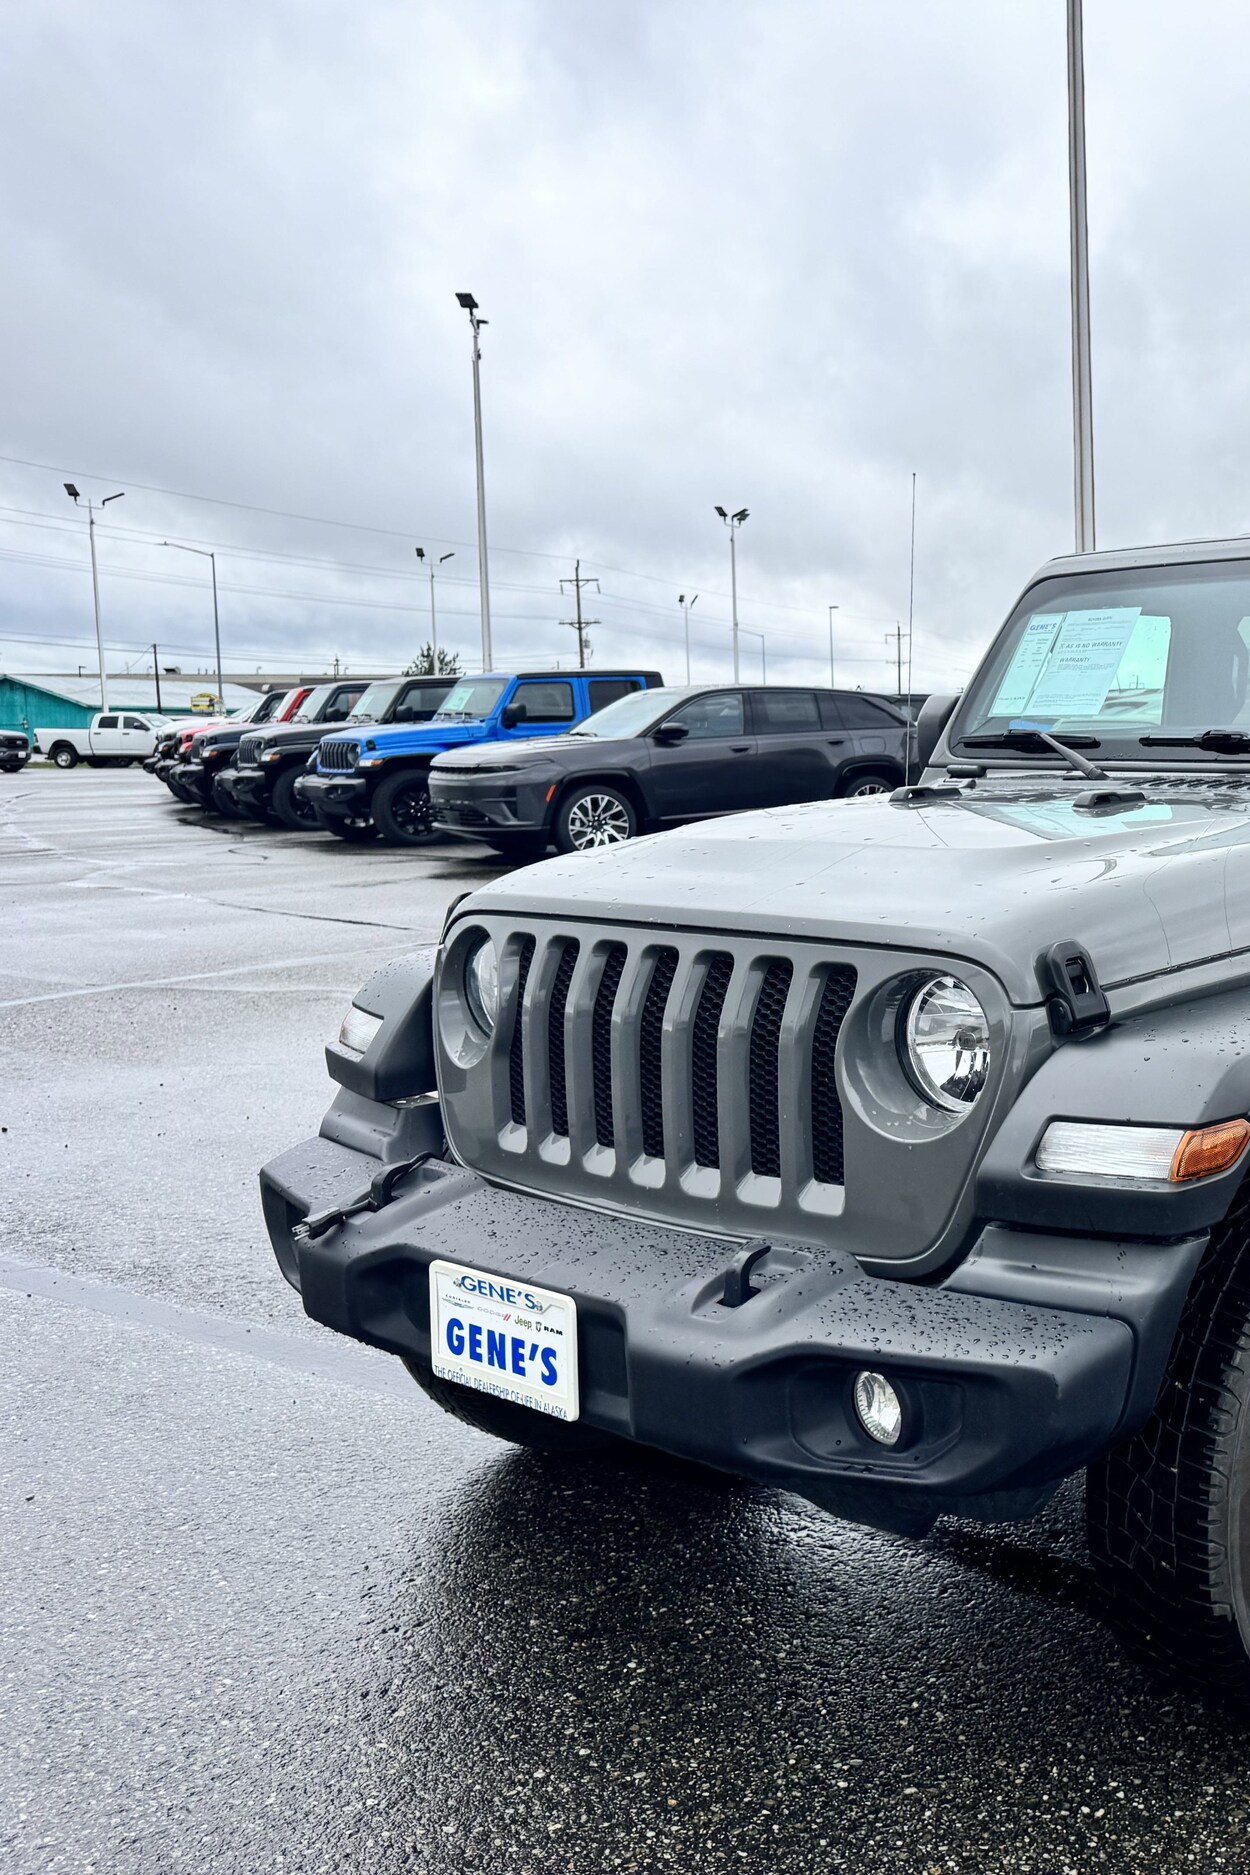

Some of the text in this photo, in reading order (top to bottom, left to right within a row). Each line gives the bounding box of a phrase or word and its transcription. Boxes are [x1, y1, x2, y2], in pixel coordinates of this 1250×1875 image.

[460, 1275, 537, 1310] GENE'S
[514, 1315, 533, 1331] Jeep
[543, 1326, 563, 1336] RAM
[446, 1317, 558, 1386] GENE'S
